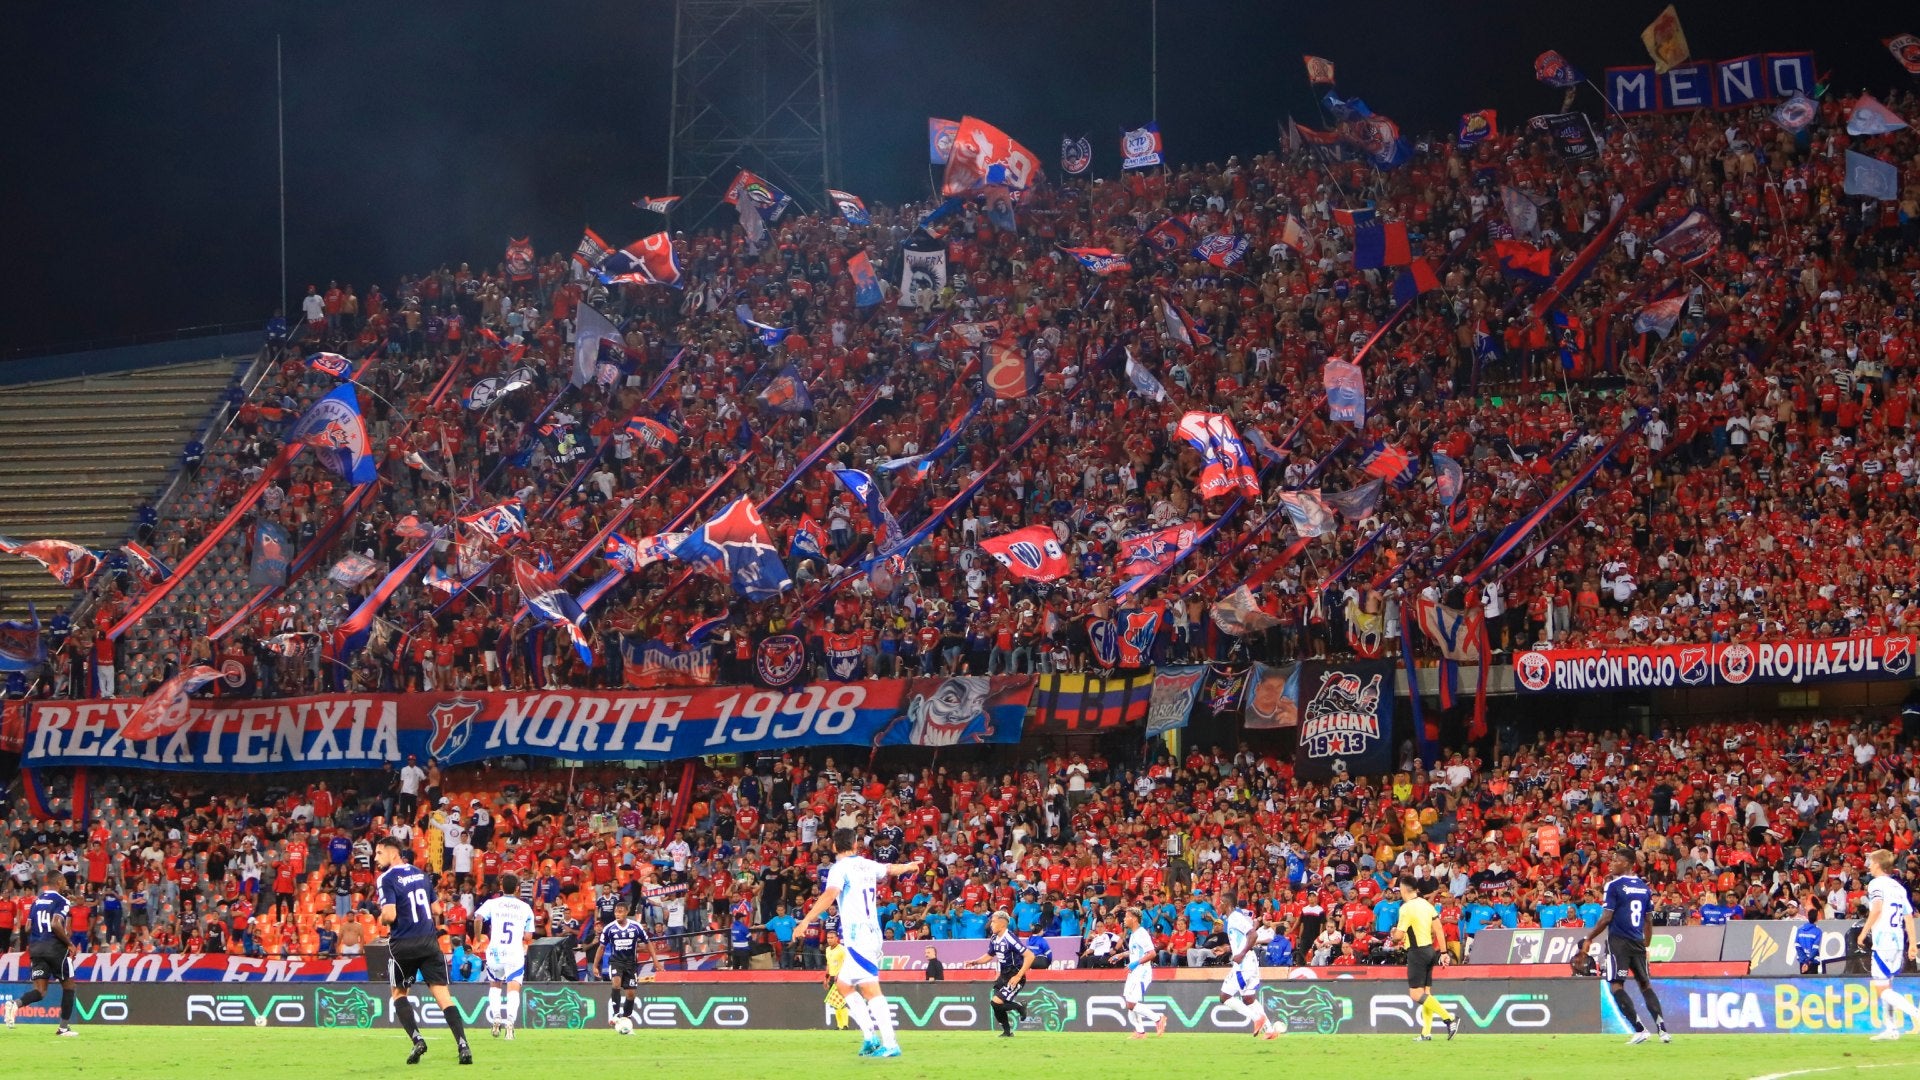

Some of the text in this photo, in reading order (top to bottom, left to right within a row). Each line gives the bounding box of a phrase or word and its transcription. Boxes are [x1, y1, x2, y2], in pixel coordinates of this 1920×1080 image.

[1555, 649, 1676, 689] RINCÓN ROJO
[1759, 637, 1880, 684] ROJIAZUL
[485, 685, 867, 752] NORTE 1998
[1306, 712, 1374, 739] BELGAX
[408, 888, 432, 923] 19
[863, 887, 875, 917] 17
[1630, 900, 1642, 927] 8
[36, 910, 51, 934] 14
[501, 921, 515, 945] 5
[187, 994, 305, 1022] REVO
[1688, 992, 1766, 1028] LIGA
